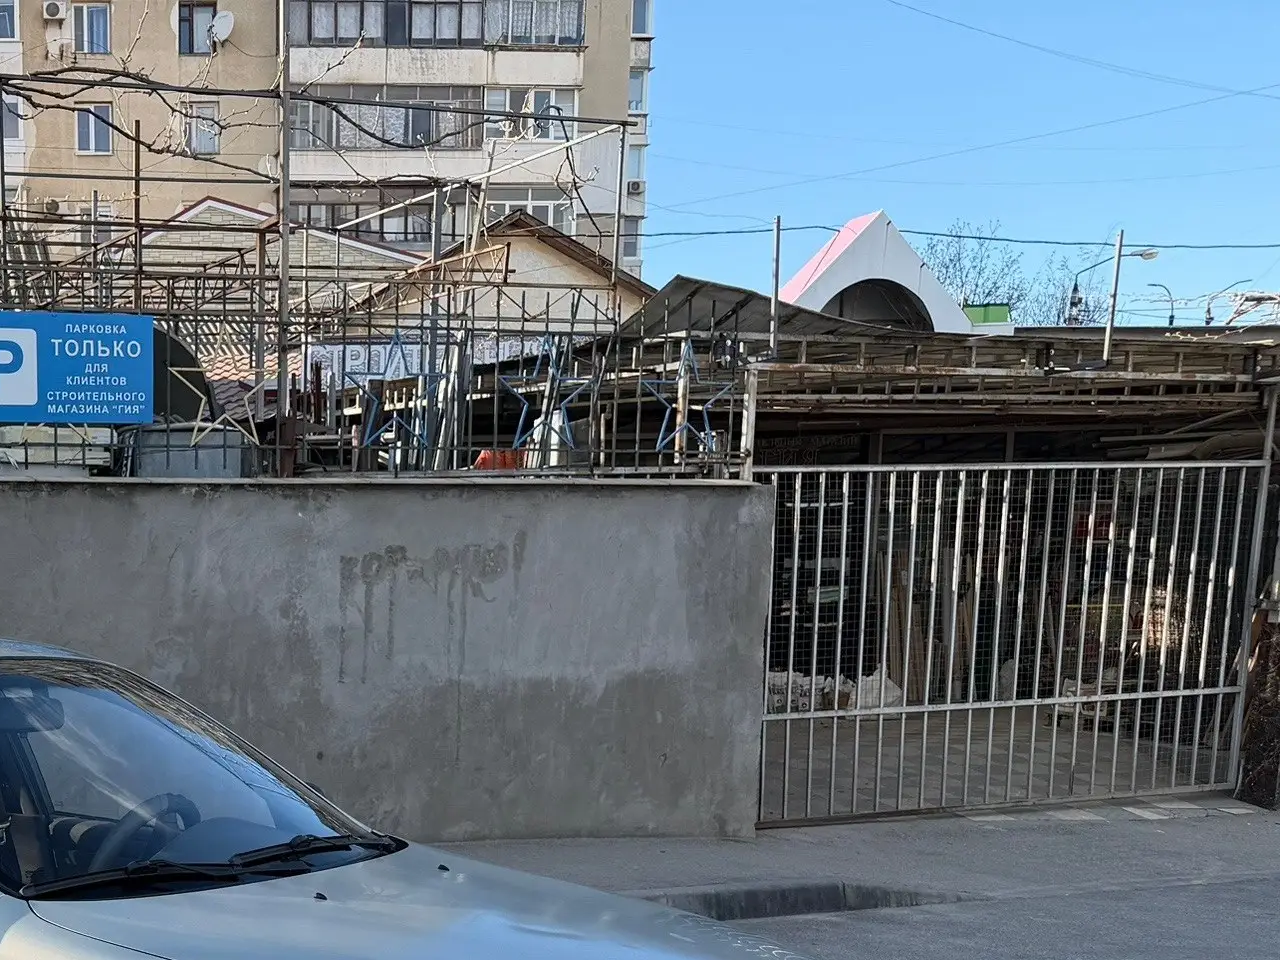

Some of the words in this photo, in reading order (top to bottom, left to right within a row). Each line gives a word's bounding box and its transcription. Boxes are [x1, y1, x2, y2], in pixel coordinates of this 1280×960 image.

[65, 323, 127, 334] ПАРКОВКА
[50, 338, 142, 358] ТОЛЬКО
[84, 363, 108, 374] ДЛЯ
[66, 375, 127, 386] КЛИЕНТОВ
[47, 391, 146, 402] СТРОИТЕЛЬНОГО
[47, 404, 109, 414] МАГАЗИНА
